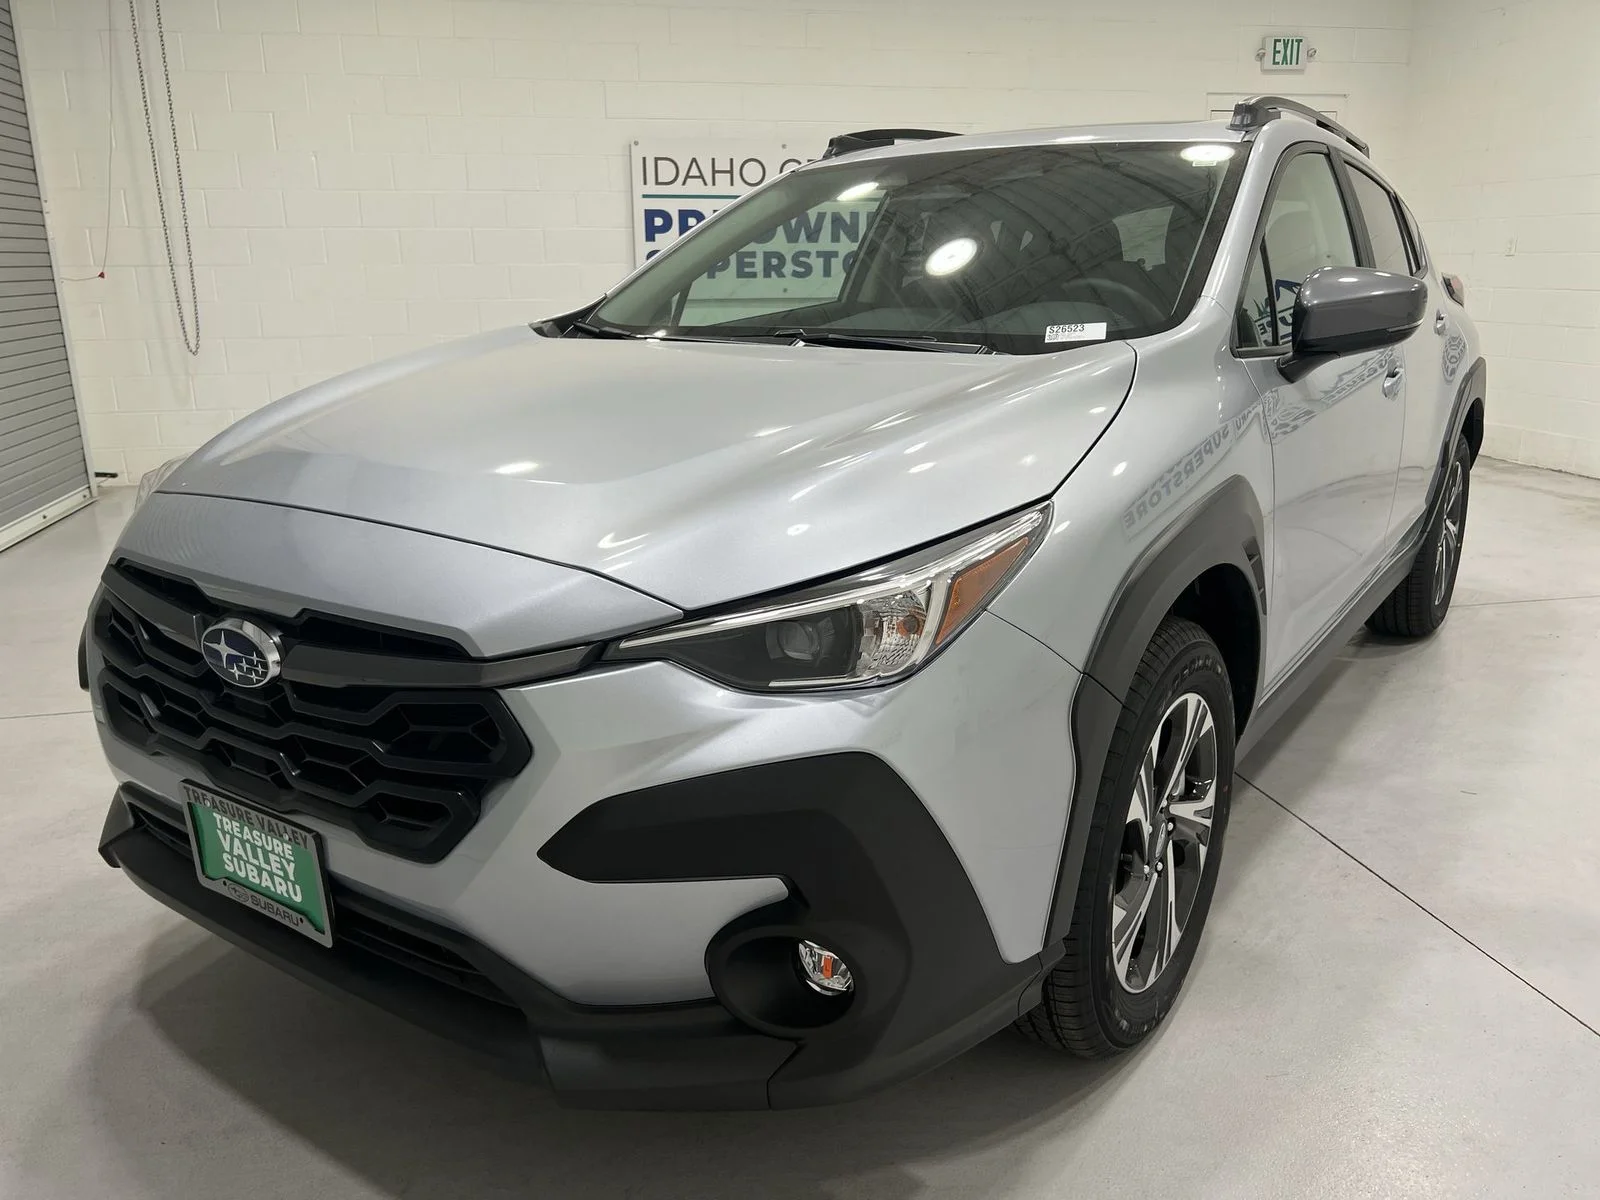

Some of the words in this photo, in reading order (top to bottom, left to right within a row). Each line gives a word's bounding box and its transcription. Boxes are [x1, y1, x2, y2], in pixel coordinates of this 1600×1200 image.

[1272, 39, 1303, 65] EXIT
[641, 156, 766, 187] IDAHO
[1049, 324, 1085, 334] S26523
[184, 787, 255, 826] TREASURE
[256, 815, 309, 849] VALLEY
[213, 812, 295, 861] TREASURE
[216, 829, 296, 881] VALLEY
[222, 852, 303, 903] SUBARU
[250, 894, 299, 927] SUBARU
